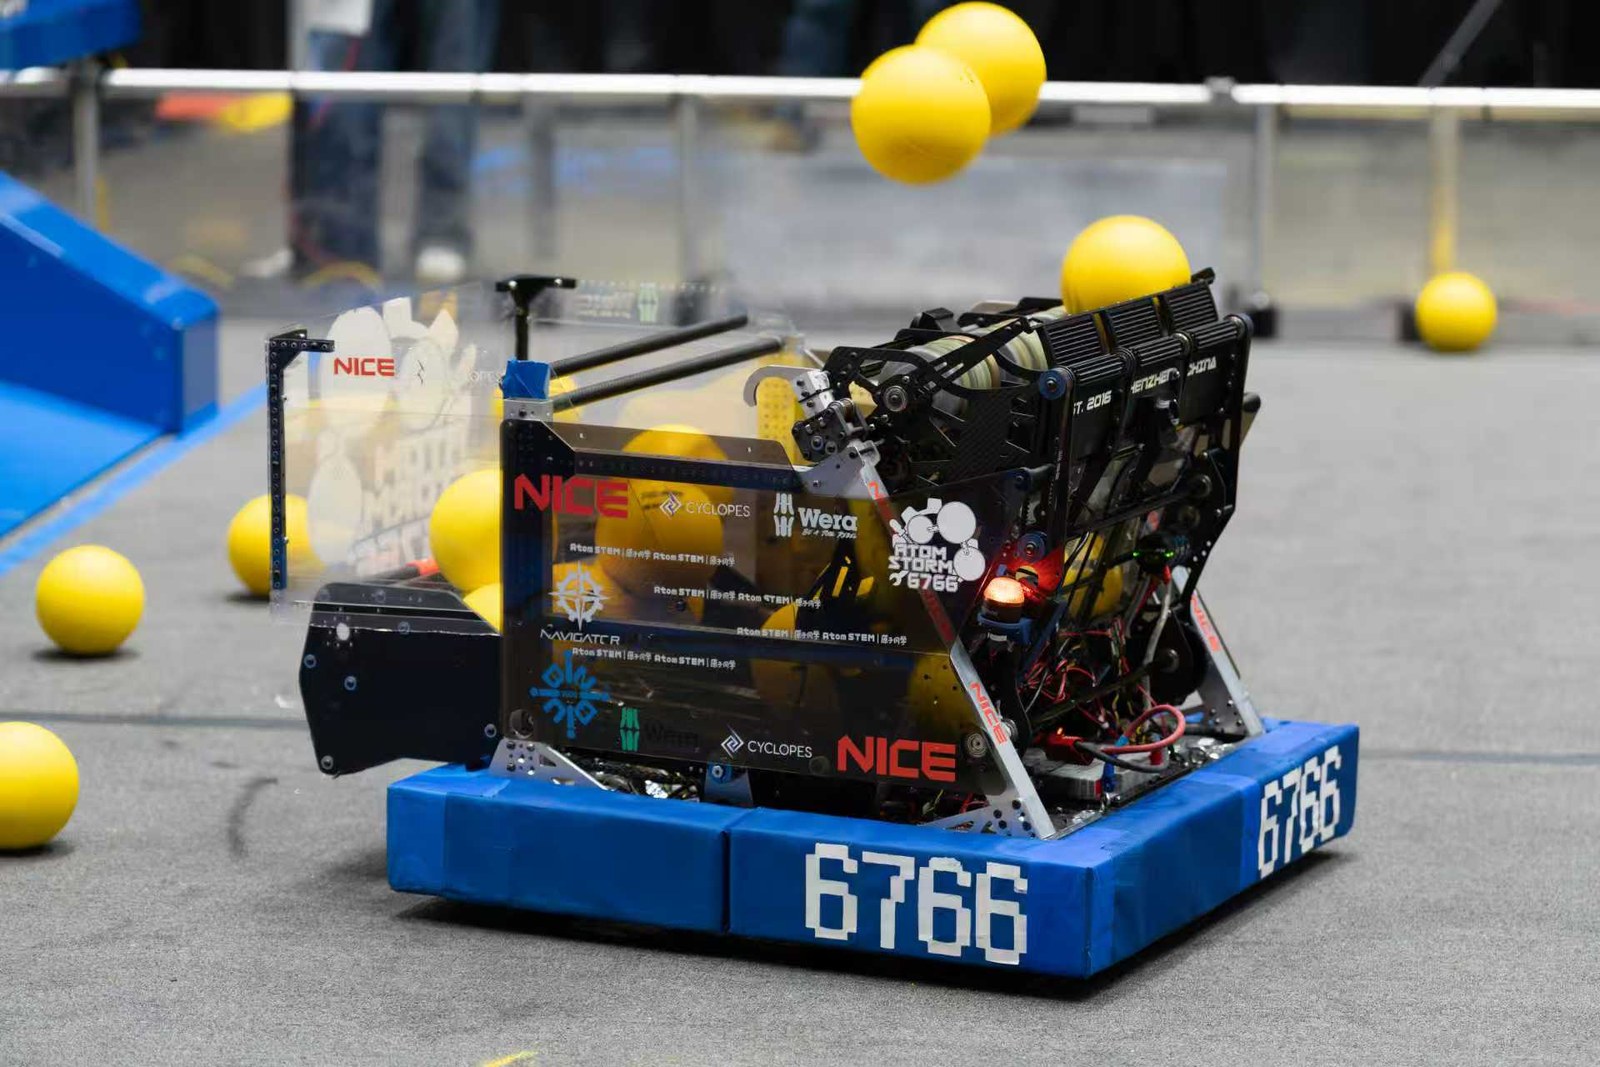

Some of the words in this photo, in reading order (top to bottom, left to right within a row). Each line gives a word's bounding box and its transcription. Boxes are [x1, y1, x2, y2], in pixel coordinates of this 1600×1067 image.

[334, 357, 395, 377] NICE
[1086, 390, 1112, 411] 2016
[514, 473, 628, 519] NICE
[686, 501, 750, 517] CYCLOPES
[798, 507, 857, 532] Wera
[570, 542, 593, 553] Atom
[595, 545, 620, 556] STEM
[653, 551, 676, 561] Atom
[678, 553, 704, 564] STEM
[894, 543, 947, 560] ATOM
[888, 556, 953, 575] STORM
[907, 572, 958, 593] 6766
[653, 586, 677, 597] Atom
[679, 587, 705, 598] STEM
[738, 592, 762, 603] Atom
[764, 593, 790, 605] STEM
[737, 626, 761, 637] Atom
[762, 627, 789, 638] STEM
[823, 631, 847, 641] Atom
[848, 632, 876, 643] STEM
[572, 647, 595, 657] Atom
[597, 648, 622, 660] STEM
[654, 654, 678, 664] Atom
[679, 655, 705, 667] STEM
[970, 682, 1008, 746] NICE
[747, 740, 813, 758] CYCLOPES
[837, 734, 956, 782] NICE
[1258, 745, 1342, 880] 6766
[805, 842, 1028, 965] 6766
